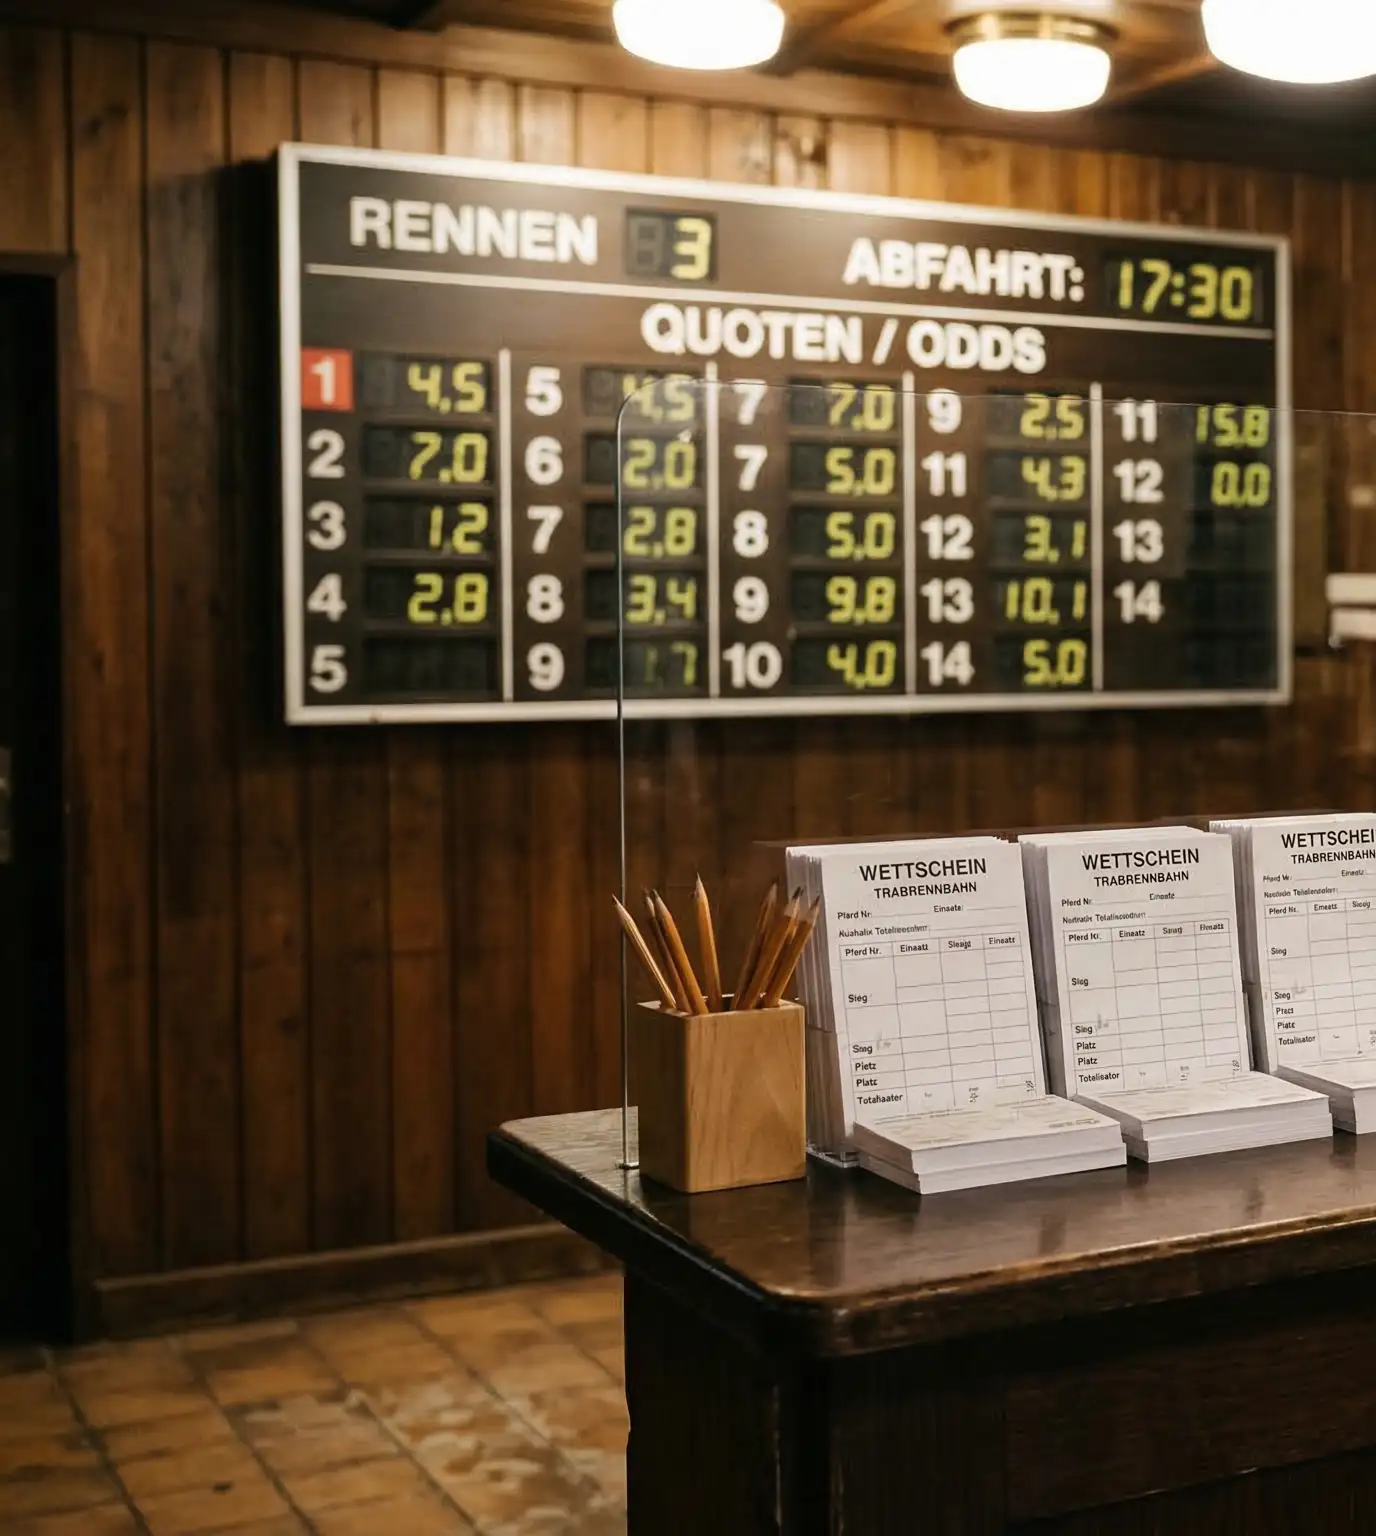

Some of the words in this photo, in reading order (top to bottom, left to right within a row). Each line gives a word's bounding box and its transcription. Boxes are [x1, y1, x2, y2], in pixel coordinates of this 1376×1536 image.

[350, 196, 598, 265] RENNEN
[671, 216, 712, 281] 3
[842, 238, 1085, 302] ABFAHRT:
[1119, 259, 1253, 321] 17:30
[641, 302, 862, 364] QUOTEN
[872, 318, 898, 366] /
[907, 320, 1047, 374] ODDS
[311, 356, 337, 405] 1
[525, 366, 562, 416] 5
[731, 378, 767, 425] 7
[926, 388, 962, 433] 9
[1113, 399, 1157, 442] 11
[307, 429, 345, 478] 2
[525, 436, 563, 485] 6
[733, 445, 768, 491] 7
[920, 452, 967, 497] 11
[1113, 459, 1163, 503] 12
[307, 501, 346, 550] 3
[527, 506, 563, 554] 7
[733, 510, 768, 558] 8
[920, 514, 974, 560] 12
[1113, 519, 1163, 562] 13
[307, 574, 347, 621] 4
[526, 574, 564, 624] 8
[733, 576, 769, 624] 9
[920, 578, 974, 623] 13
[1114, 580, 1164, 623] 14
[309, 644, 347, 692] 5
[527, 643, 564, 691] 9
[722, 642, 782, 690] 10
[920, 641, 975, 687] 14
[859, 858, 986, 881] WETTSCHEIN
[1082, 848, 1200, 871] WETTSCHEIN
[1093, 870, 1189, 888] TRABRENNBAHN
[1291, 849, 1376, 865] TRABRENNBAHN
[874, 882, 977, 899] TRABRENNBAHN
[1076, 1040, 1096, 1050] Platz
